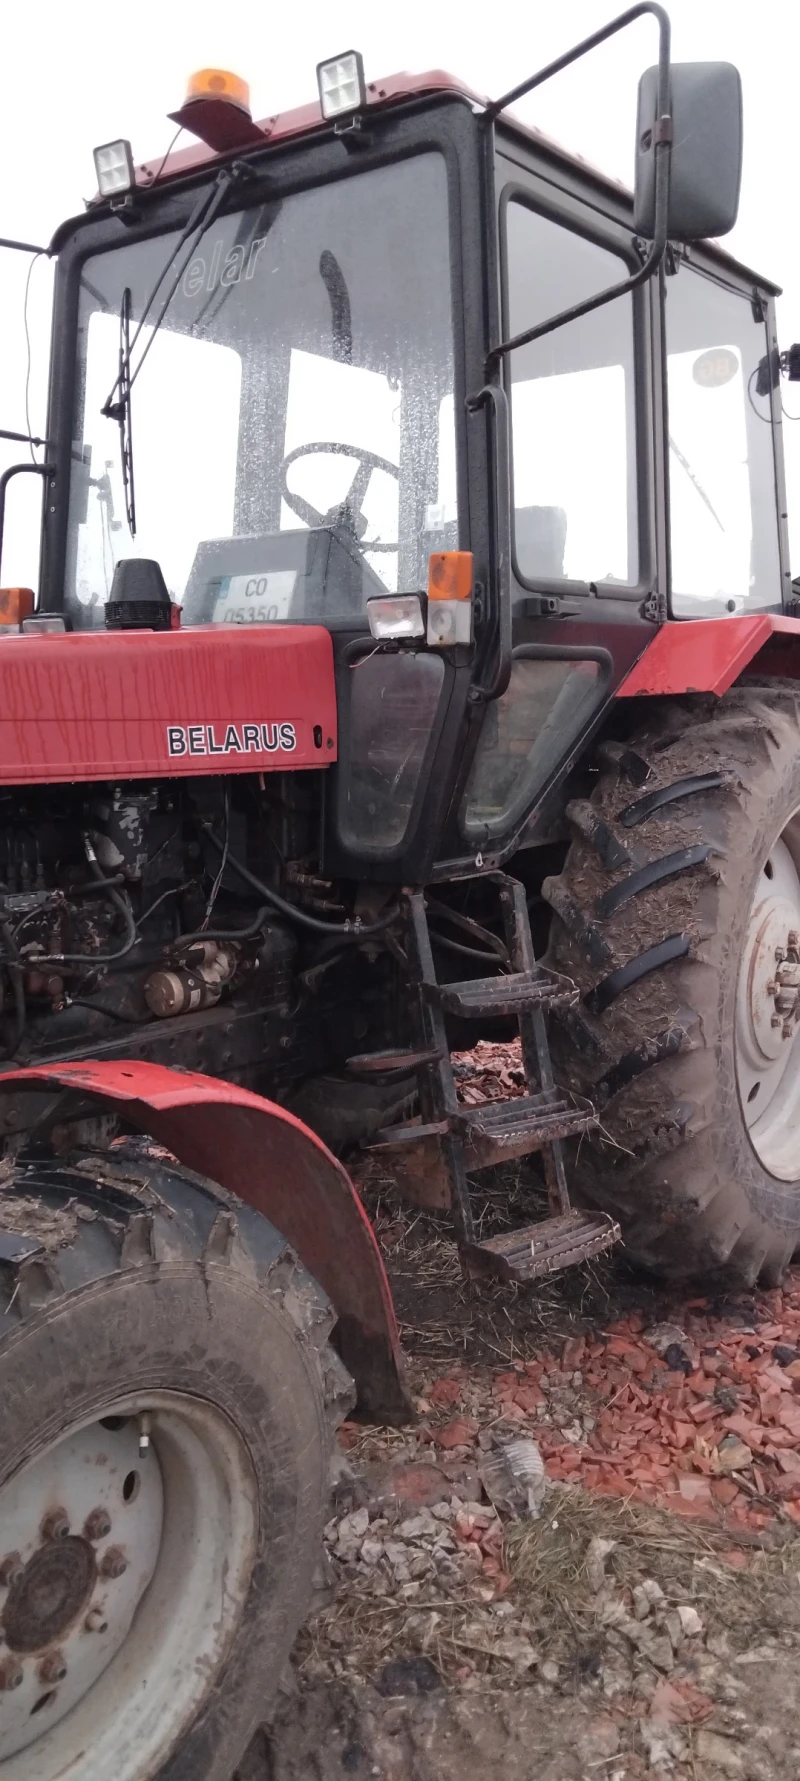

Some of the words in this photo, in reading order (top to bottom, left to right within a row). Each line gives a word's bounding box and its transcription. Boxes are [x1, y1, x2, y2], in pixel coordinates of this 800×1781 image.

[170, 237, 267, 301] elar
[245, 577, 268, 597] CO
[223, 604, 279, 623] 05350
[166, 722, 297, 756] BELARUS
